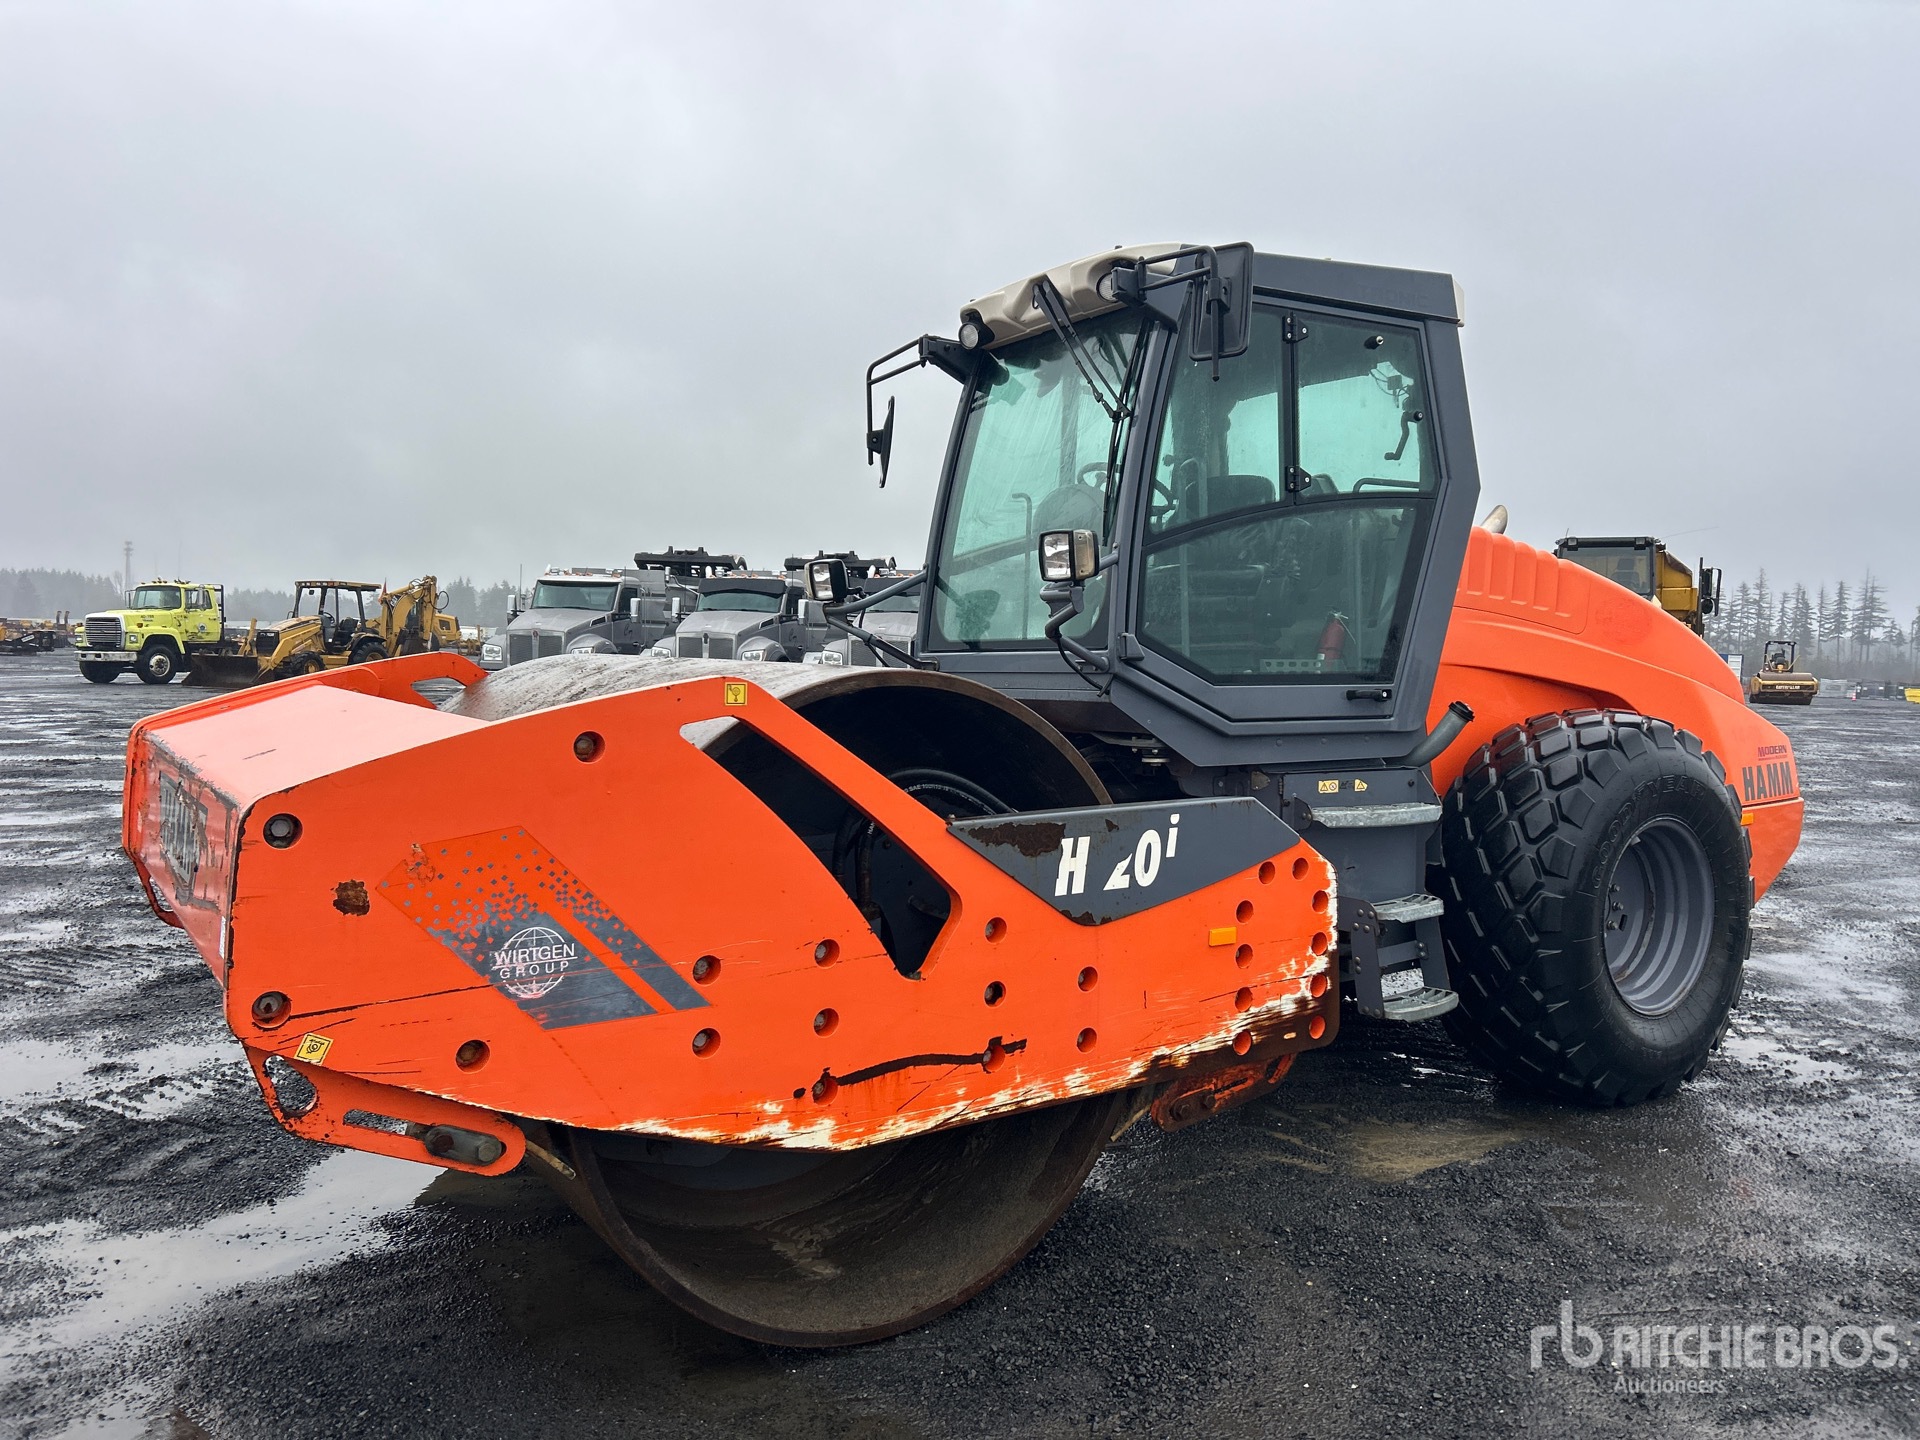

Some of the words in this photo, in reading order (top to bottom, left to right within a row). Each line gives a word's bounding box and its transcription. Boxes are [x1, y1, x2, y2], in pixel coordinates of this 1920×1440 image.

[1758, 745, 1787, 757] MODERN
[1742, 761, 1794, 801] HAMM
[1055, 836, 1091, 897] H
[494, 943, 575, 966] WIRTGEN
[500, 960, 569, 979] GROUP
